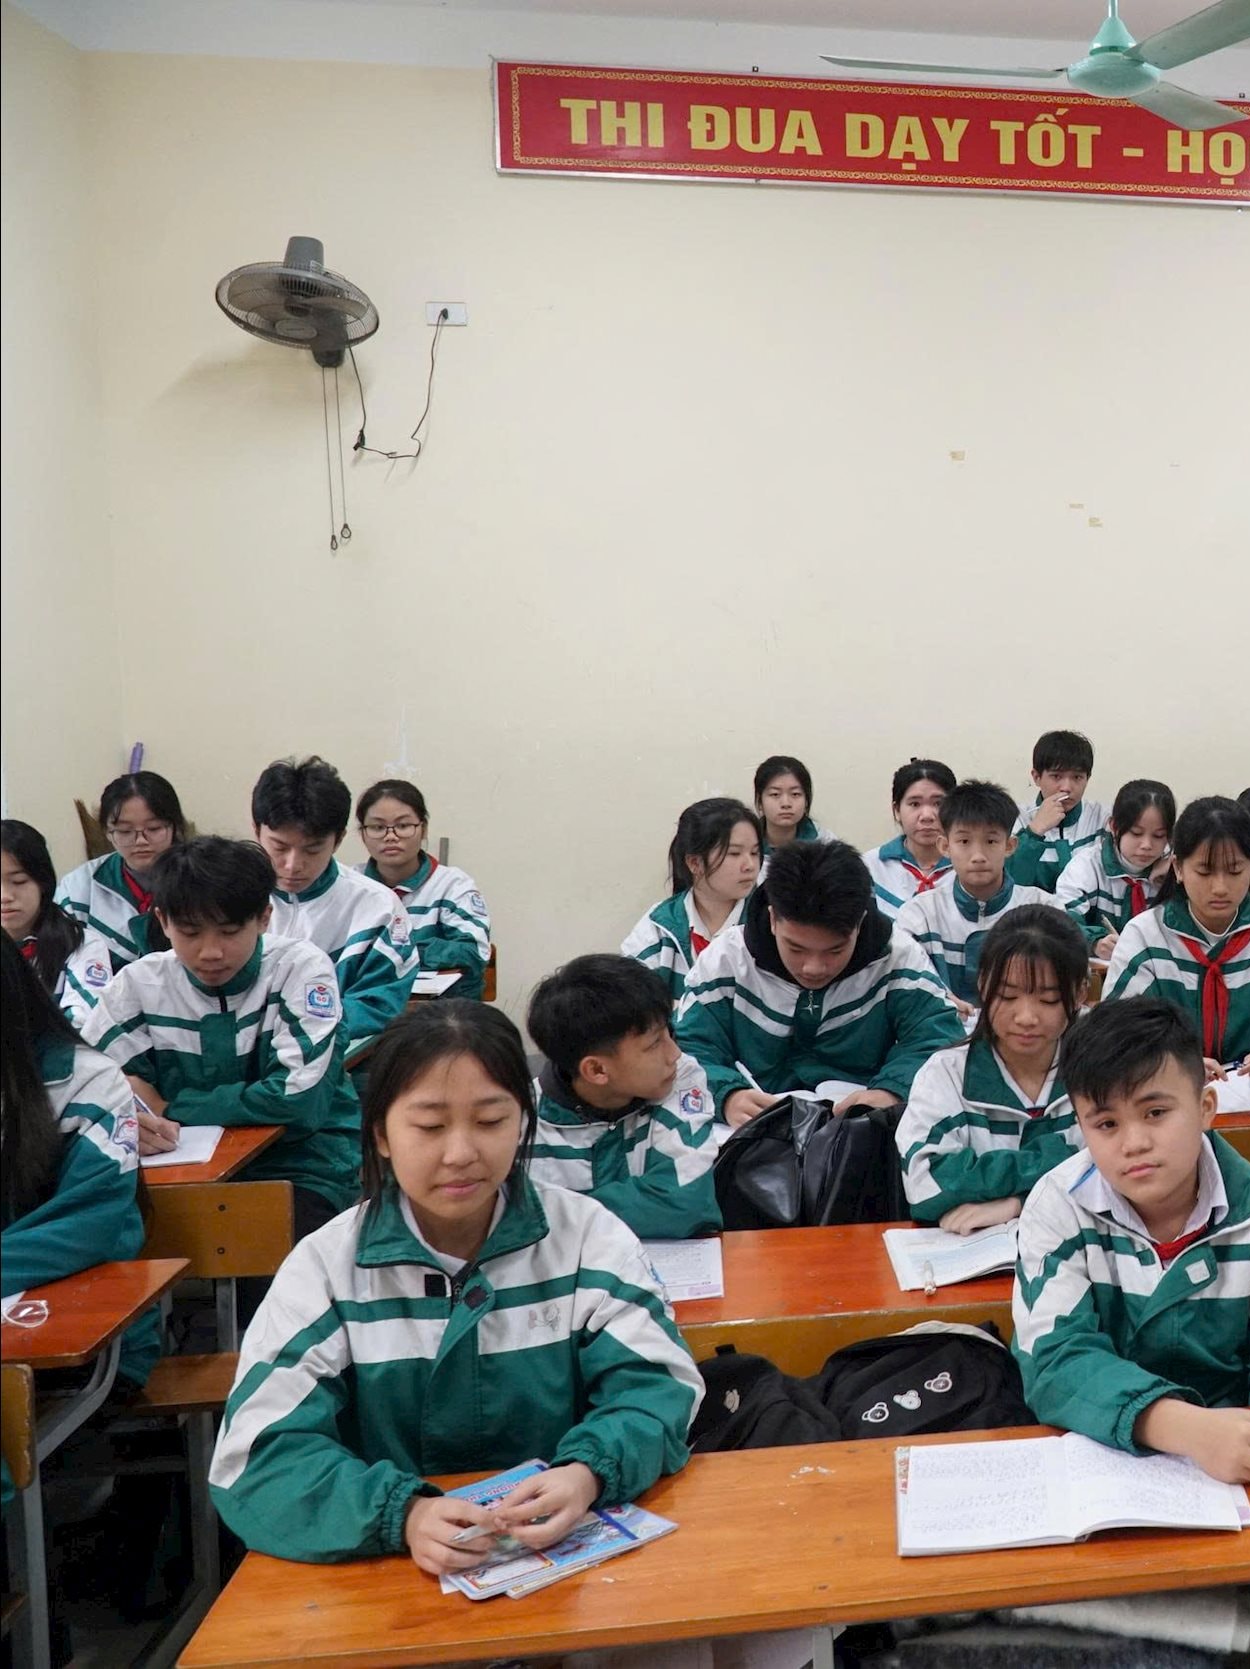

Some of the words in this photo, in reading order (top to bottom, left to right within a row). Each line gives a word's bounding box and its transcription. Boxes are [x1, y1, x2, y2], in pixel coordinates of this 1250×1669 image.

[560, 98, 665, 148] THI
[687, 104, 823, 156] ĐUA
[845, 112, 970, 170] DẠY
[990, 107, 1102, 169] TỐT
[1122, 147, 1144, 157] -
